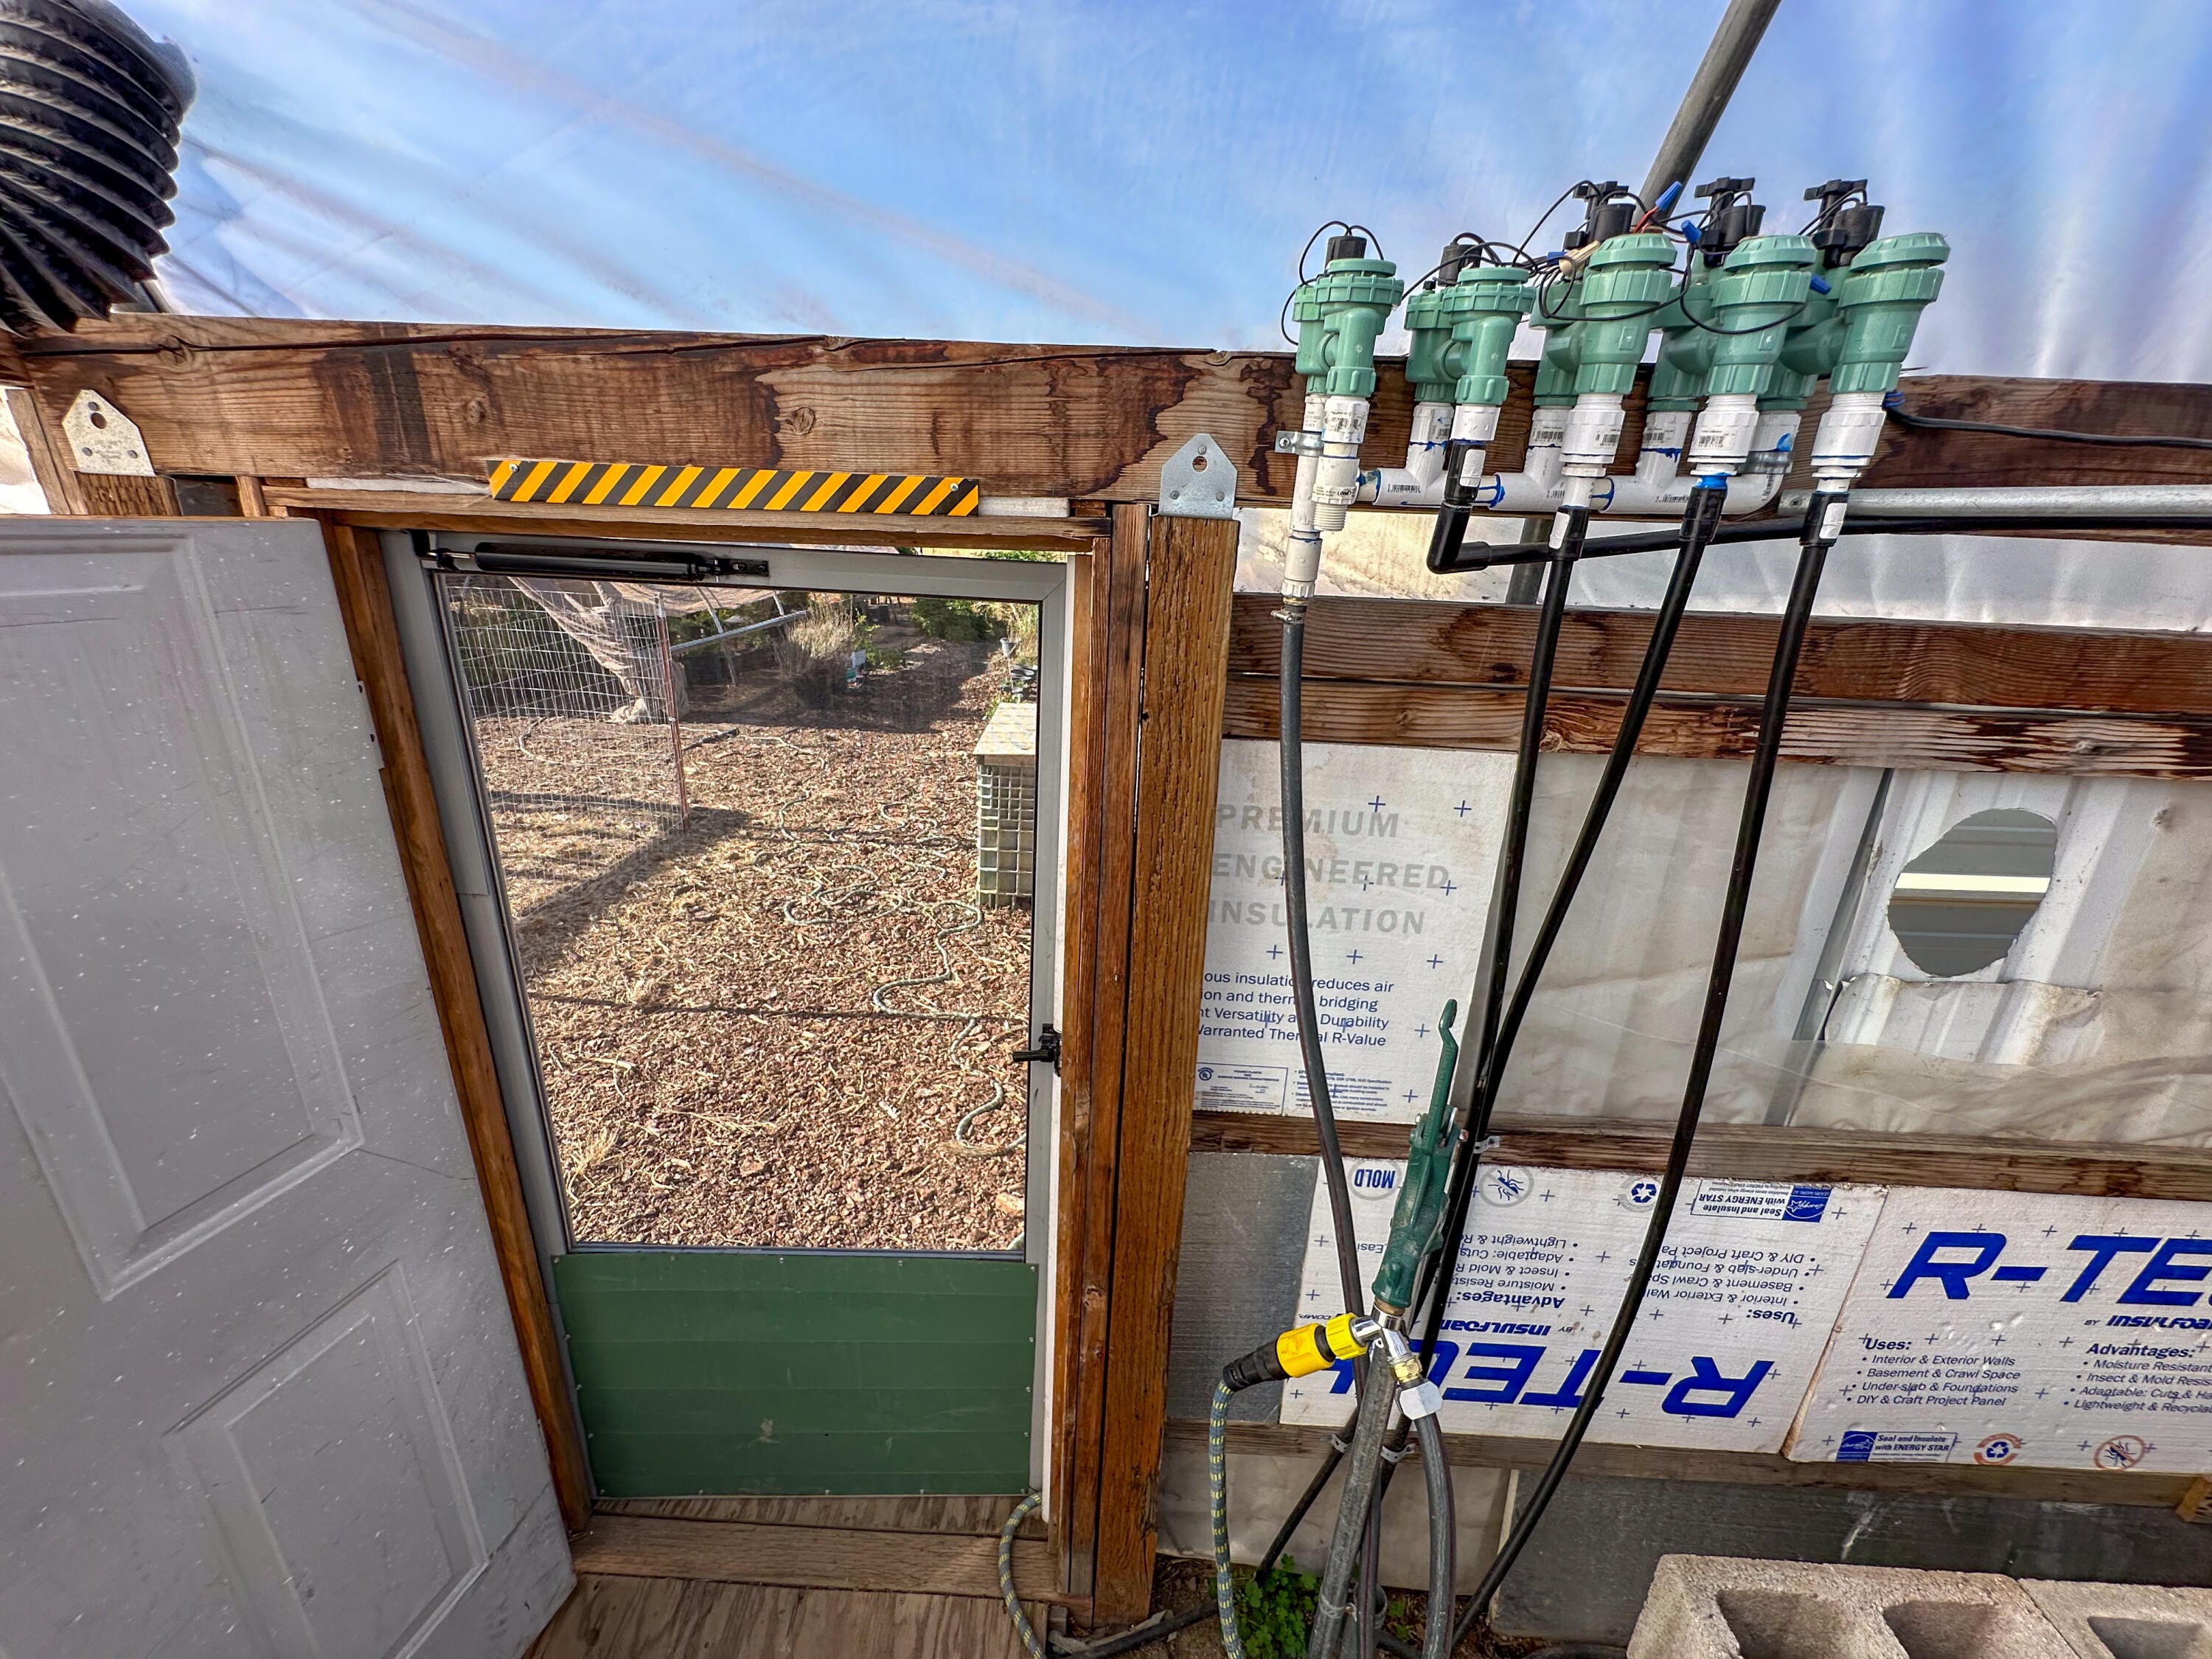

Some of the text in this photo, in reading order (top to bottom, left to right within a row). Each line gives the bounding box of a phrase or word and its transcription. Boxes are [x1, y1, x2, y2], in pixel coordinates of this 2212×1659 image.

[1211, 852, 1450, 889] ENGNEERED
[1208, 900, 1425, 935] INSUATION
[1312, 978, 1370, 992] reduces
[1374, 981, 1394, 992] air
[1225, 991, 1253, 1003] and
[1319, 995, 1379, 1012] bridging
[1214, 1007, 1284, 1025] Versatility
[1320, 1013, 1389, 1031] Durability
[1332, 1032, 1386, 1046] R-Value
[1354, 1169, 1396, 1189] MOLD
[1698, 1194, 1785, 1205] with ENERGY STAR
[1703, 1204, 1782, 1217] Seal and Insulate
[1478, 1234, 1488, 1244] &
[1492, 1234, 1567, 1248] Lightweight
[1459, 1248, 1489, 1259] Cuts
[1493, 1250, 1563, 1264] Adaptable:
[1681, 1246, 1728, 1259] Project
[1732, 1250, 1764, 1262] Craft
[1767, 1253, 1778, 1262] &
[1781, 1253, 1805, 1264] DIY
[1469, 1264, 1501, 1275] Mold
[1506, 1266, 1516, 1275] &
[1519, 1267, 1559, 1278] Insect
[1714, 1262, 1725, 1273] &
[1728, 1263, 1798, 1278] Under-slab
[1885, 1231, 2212, 1307] R-TE
[1498, 1279, 1555, 1291] Moisture
[1672, 1276, 1708, 1287] Crawl
[1712, 1279, 1723, 1289] &
[1725, 1279, 1793, 1293] Basement
[1456, 1291, 1565, 1310] Advantages:
[1673, 1290, 1724, 1303] Exterior
[1728, 1293, 1738, 1303] &
[1742, 1294, 1788, 1305] Interior
[1746, 1309, 1796, 1324] Uses:
[1865, 1338, 1912, 1350] Uses:
[2085, 1343, 2196, 1360] Advantages:
[1871, 1354, 2016, 1366] Interior & Exterior Walls
[2093, 1359, 2150, 1371] Moisture
[1866, 1368, 2021, 1381] Basement & Crawl Space
[2086, 1372, 2212, 1386] Insect & Mold Resis
[1862, 1382, 2019, 1393] Under-slab & Foundations
[2182, 1390, 2192, 1399] &
[1857, 1395, 2008, 1407] DIY & Craft Project Panel
[2073, 1399, 2146, 1412] Lightweight
[2147, 1402, 2158, 1411] &
[1893, 1444, 1927, 1452] ENERGY
